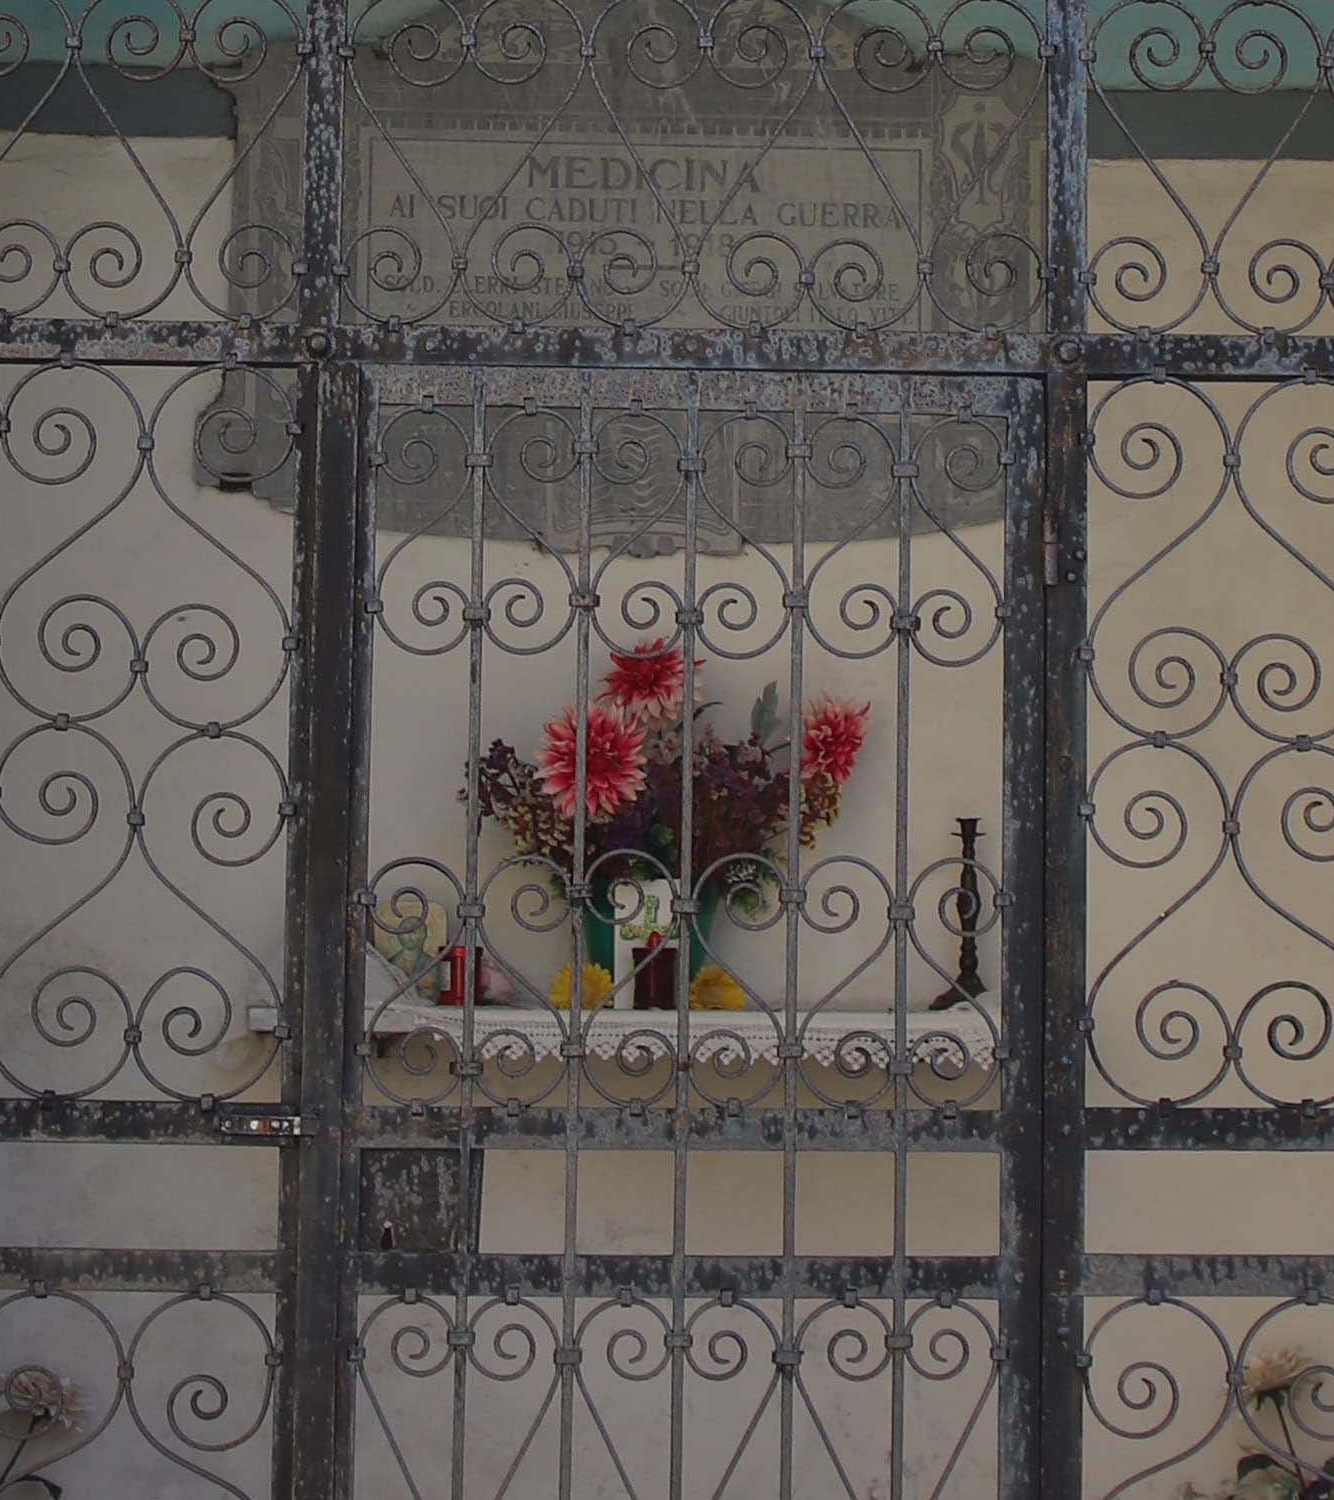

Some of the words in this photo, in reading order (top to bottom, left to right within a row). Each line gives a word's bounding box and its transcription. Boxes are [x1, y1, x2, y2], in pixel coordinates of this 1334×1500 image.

[527, 154, 762, 194] MEDICINA
[389, 193, 416, 219] AI
[437, 193, 508, 221] SUOI
[525, 196, 637, 224] CADUTI
[652, 199, 760, 227] NELLA
[776, 201, 906, 230] GUERRA
